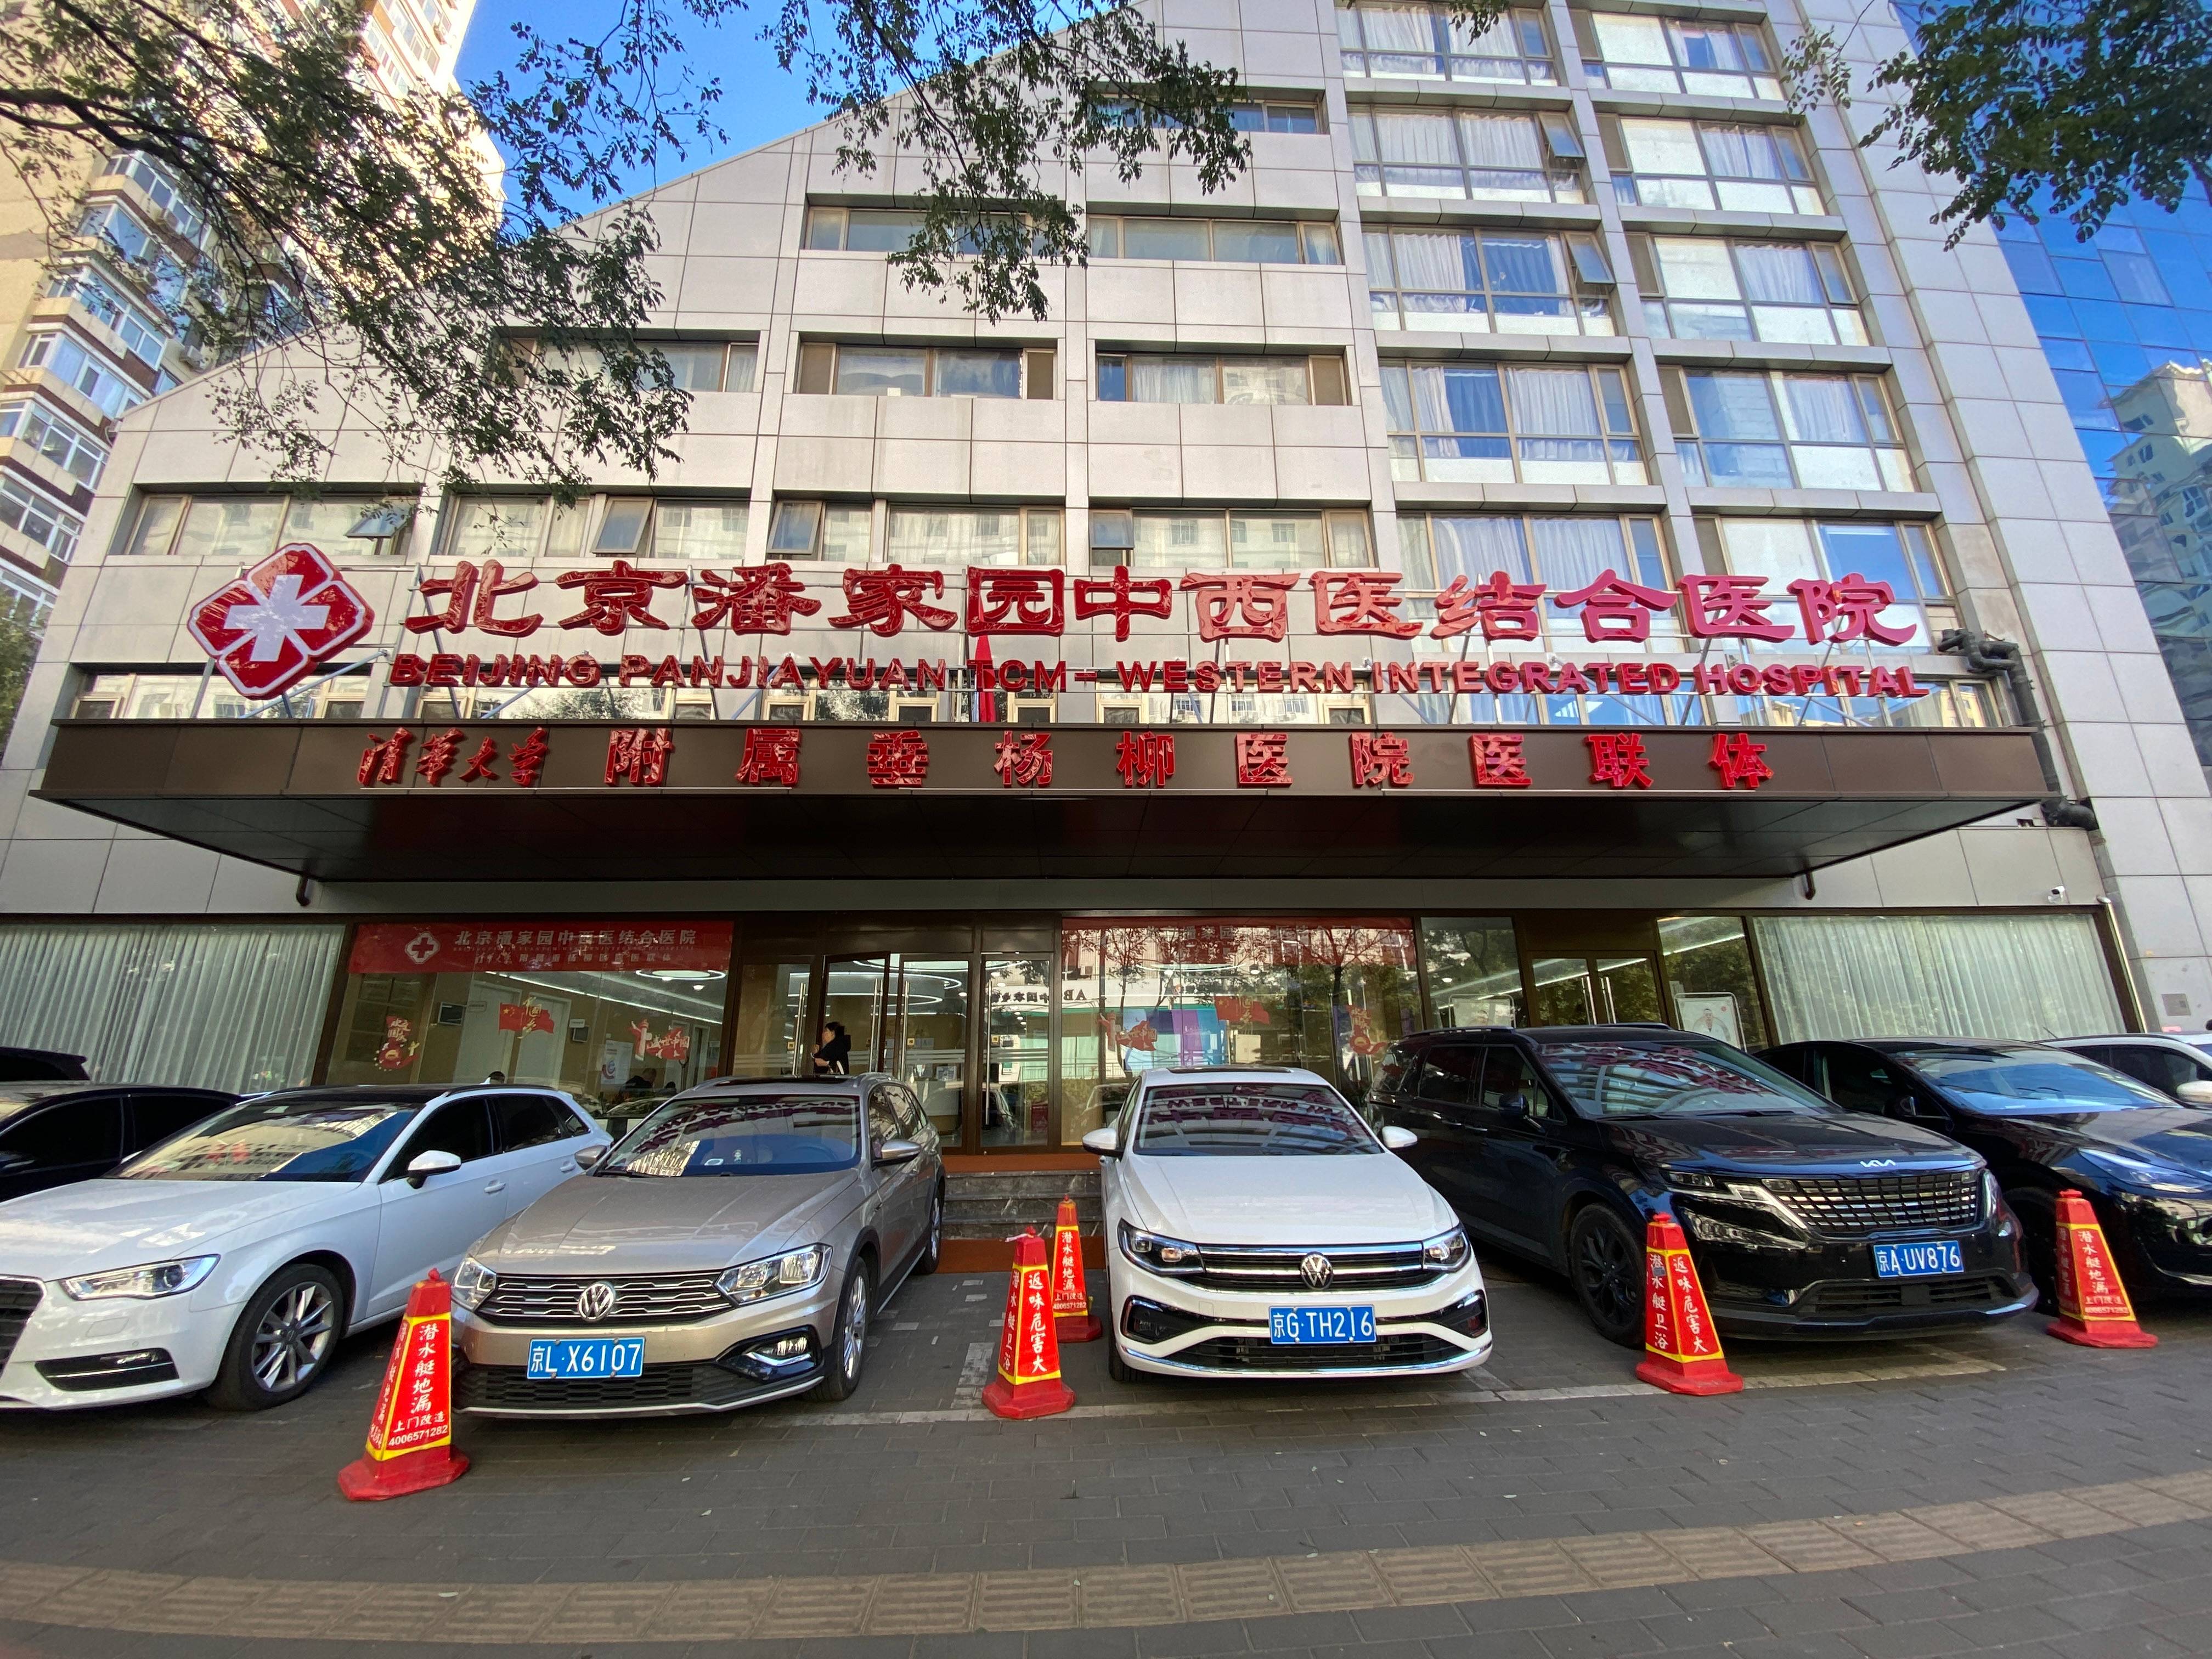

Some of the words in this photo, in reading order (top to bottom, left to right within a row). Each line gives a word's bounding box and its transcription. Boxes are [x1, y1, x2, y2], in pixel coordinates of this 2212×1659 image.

[404, 560, 1916, 646] 北京潘家园中西医结合医院
[388, 652, 602, 688] BEIJING
[618, 654, 946, 692] PANJIAYUAN
[1372, 662, 1680, 695] INTEGRATED
[1692, 663, 1929, 698] HOSPITAL
[1062, 1232, 1075, 1290] 潜水艇地漏
[2078, 1231, 2108, 1294] 潜水艇地漏
[1028, 1272, 1047, 1373] 返味危害大
[1673, 1256, 1708, 1353] 返味危害大
[410, 1323, 439, 1414] 潜水艇地漏
[388, 1425, 448, 1447] 4006571282
[393, 1413, 445, 1432] 上门改造
